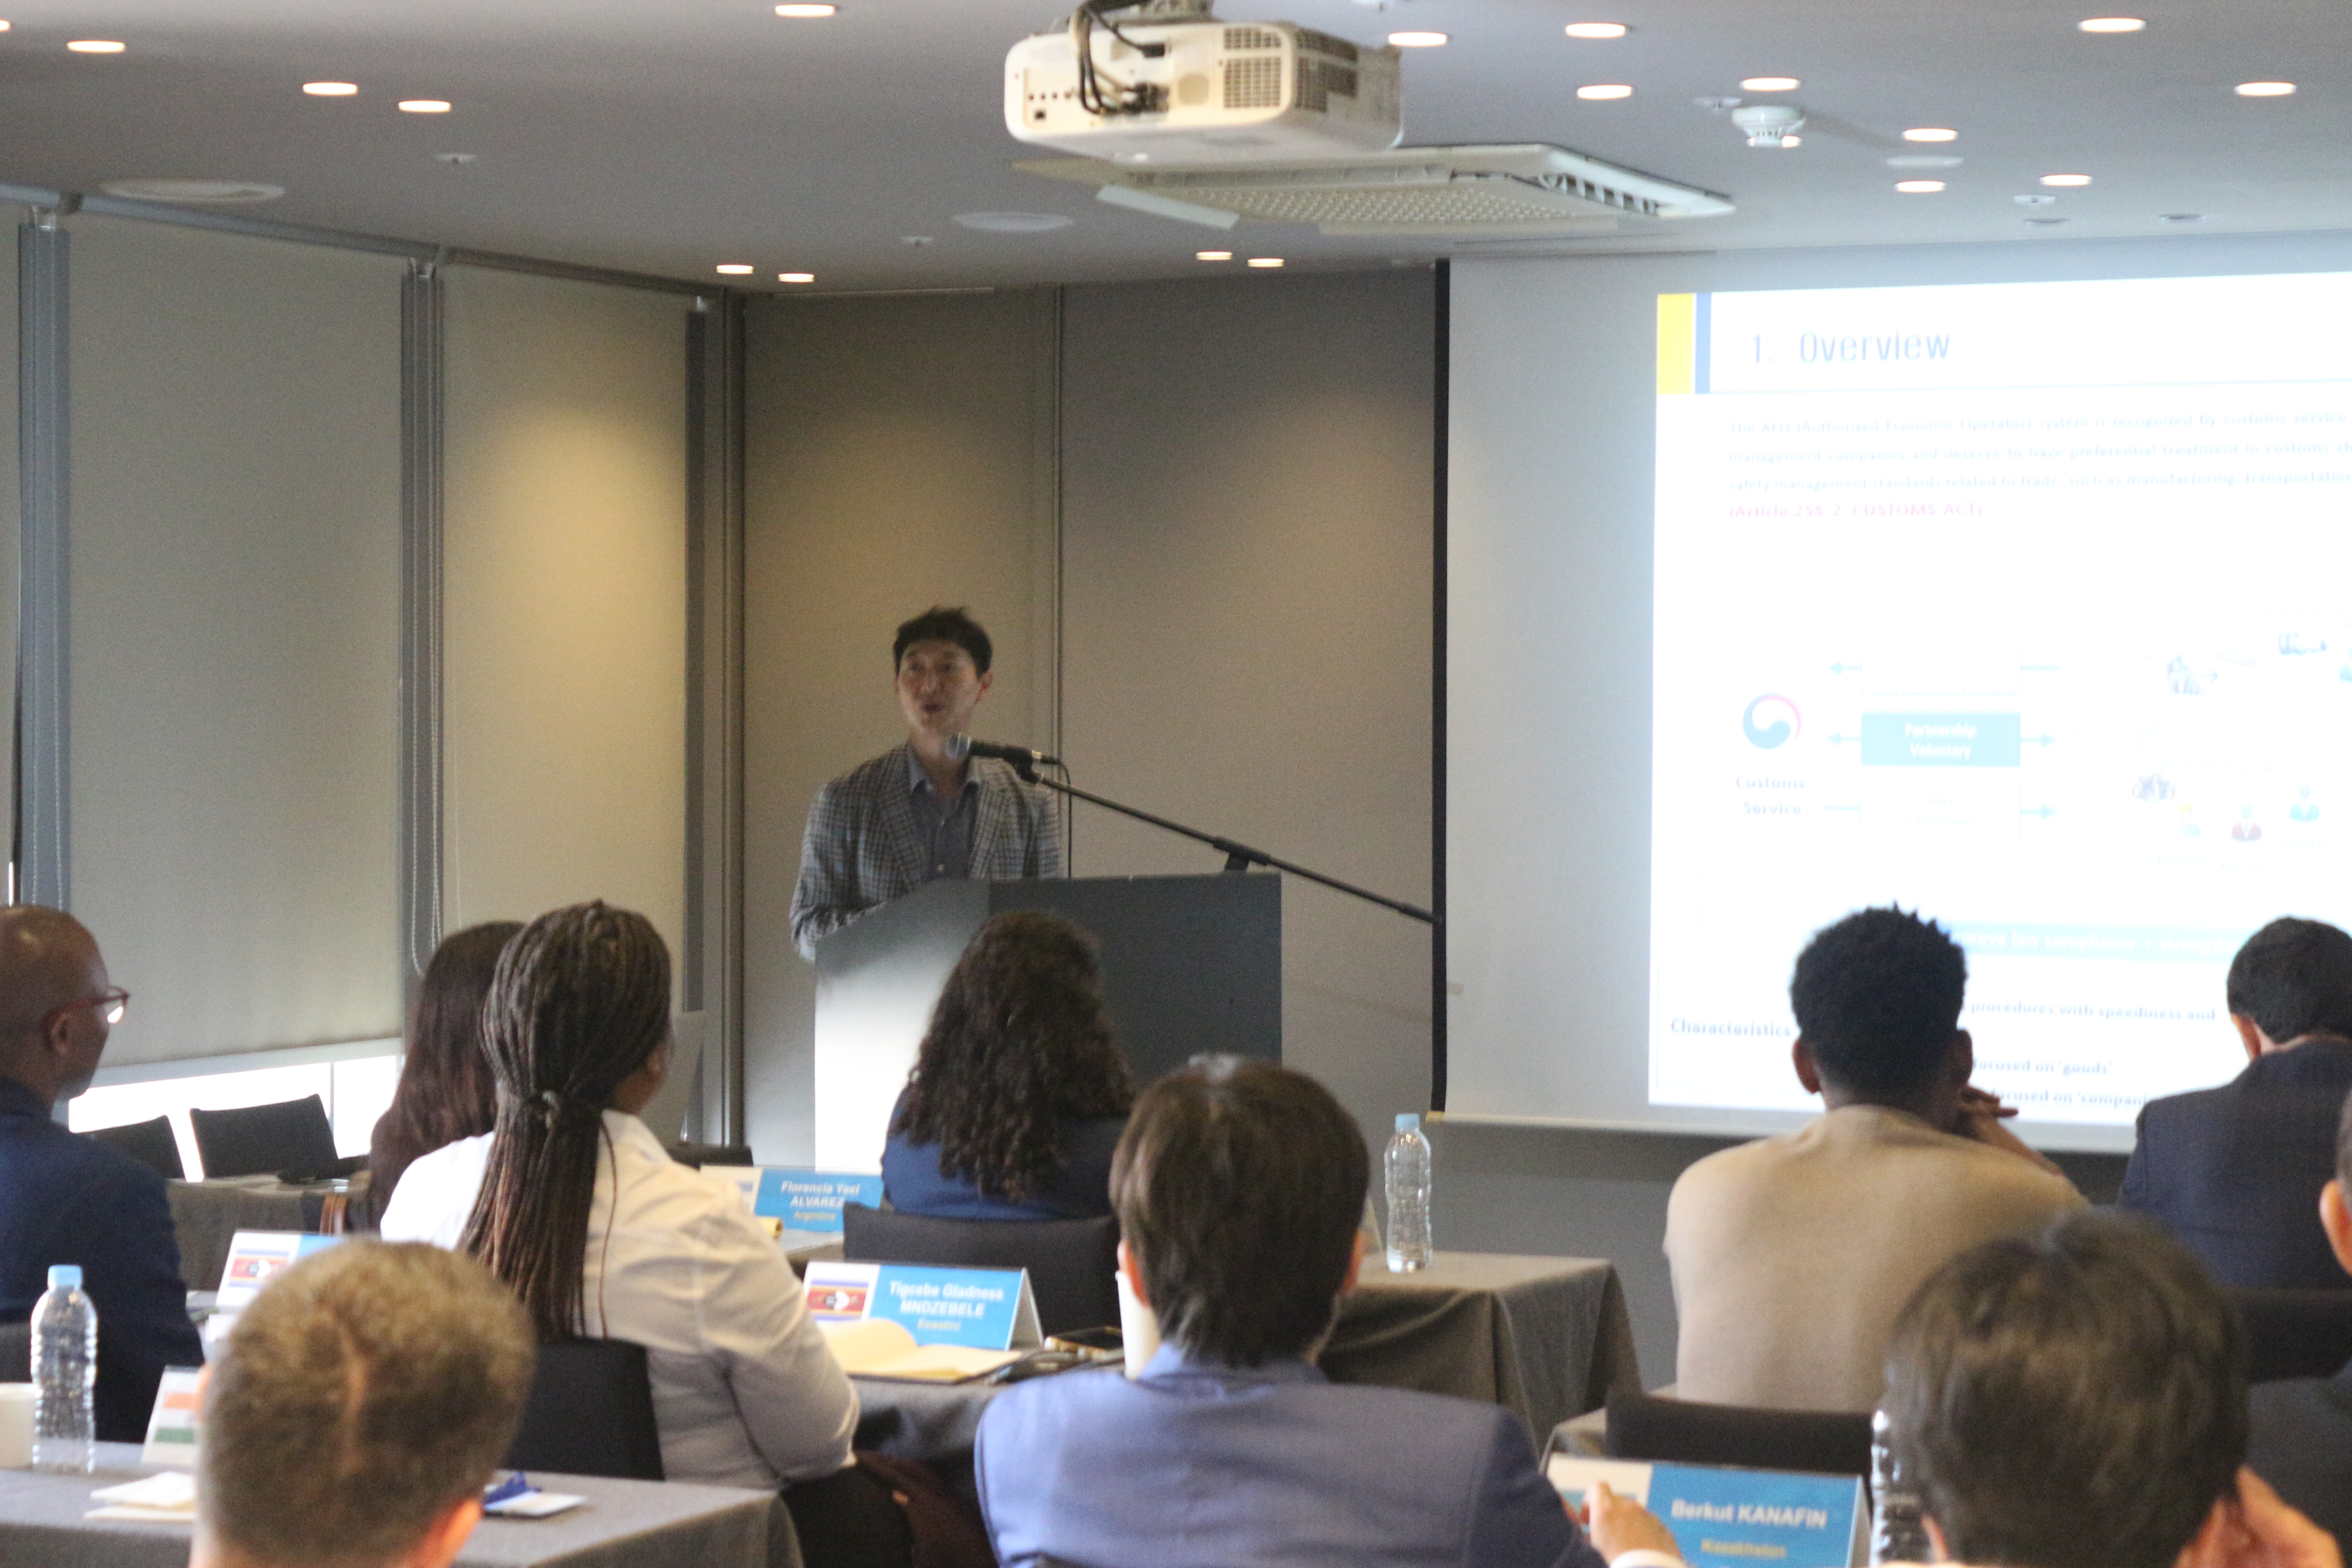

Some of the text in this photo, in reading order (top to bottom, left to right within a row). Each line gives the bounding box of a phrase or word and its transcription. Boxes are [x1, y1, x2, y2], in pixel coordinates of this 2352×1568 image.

[1752, 330, 1950, 365] 1. Overview
[1731, 411, 2347, 435] The AEO (Authorized Economic Operator) system is recognized by customs service
[1730, 451, 1821, 465] management
[1828, 451, 1904, 463] companies
[1911, 448, 1937, 460] and
[1944, 448, 2000, 460] deserve
[2008, 447, 2022, 458] to
[2029, 446, 2063, 458] have
[2070, 444, 2156, 460] preferential
[2163, 443, 2238, 456] treatment
[2245, 444, 2260, 454] in
[2266, 442, 2330, 456] customs
[1730, 478, 1770, 492] safety
[1774, 478, 1867, 492] management
[1873, 477, 1940, 489] standards
[1945, 475, 1996, 488] related
[2001, 476, 2016, 487] to
[2069, 474, 2102, 486] such
[2107, 476, 2122, 486] as
[1729, 504, 1787, 519] (Article
[1852, 503, 1936, 516] CUSTOMS
[1943, 502, 1983, 518] ACT)
[1905, 723, 1976, 739] Partnership
[1910, 743, 1971, 759] Voluntary
[1735, 774, 1805, 789] Customs
[1743, 800, 1801, 815] Service
[2012, 931, 2039, 948] law
[2045, 933, 2136, 952] compliance
[1970, 1000, 2216, 1022] procedures with speediness and
[1670, 1015, 1792, 1039] Characteristics
[2034, 1061, 2055, 1074] on
[2052, 1092, 2073, 1106] on
[781, 1181, 833, 1194] Florencia
[790, 1196, 845, 1208] ALVAREZ
[1671, 1499, 1827, 1529] Berkut KANAFIN
